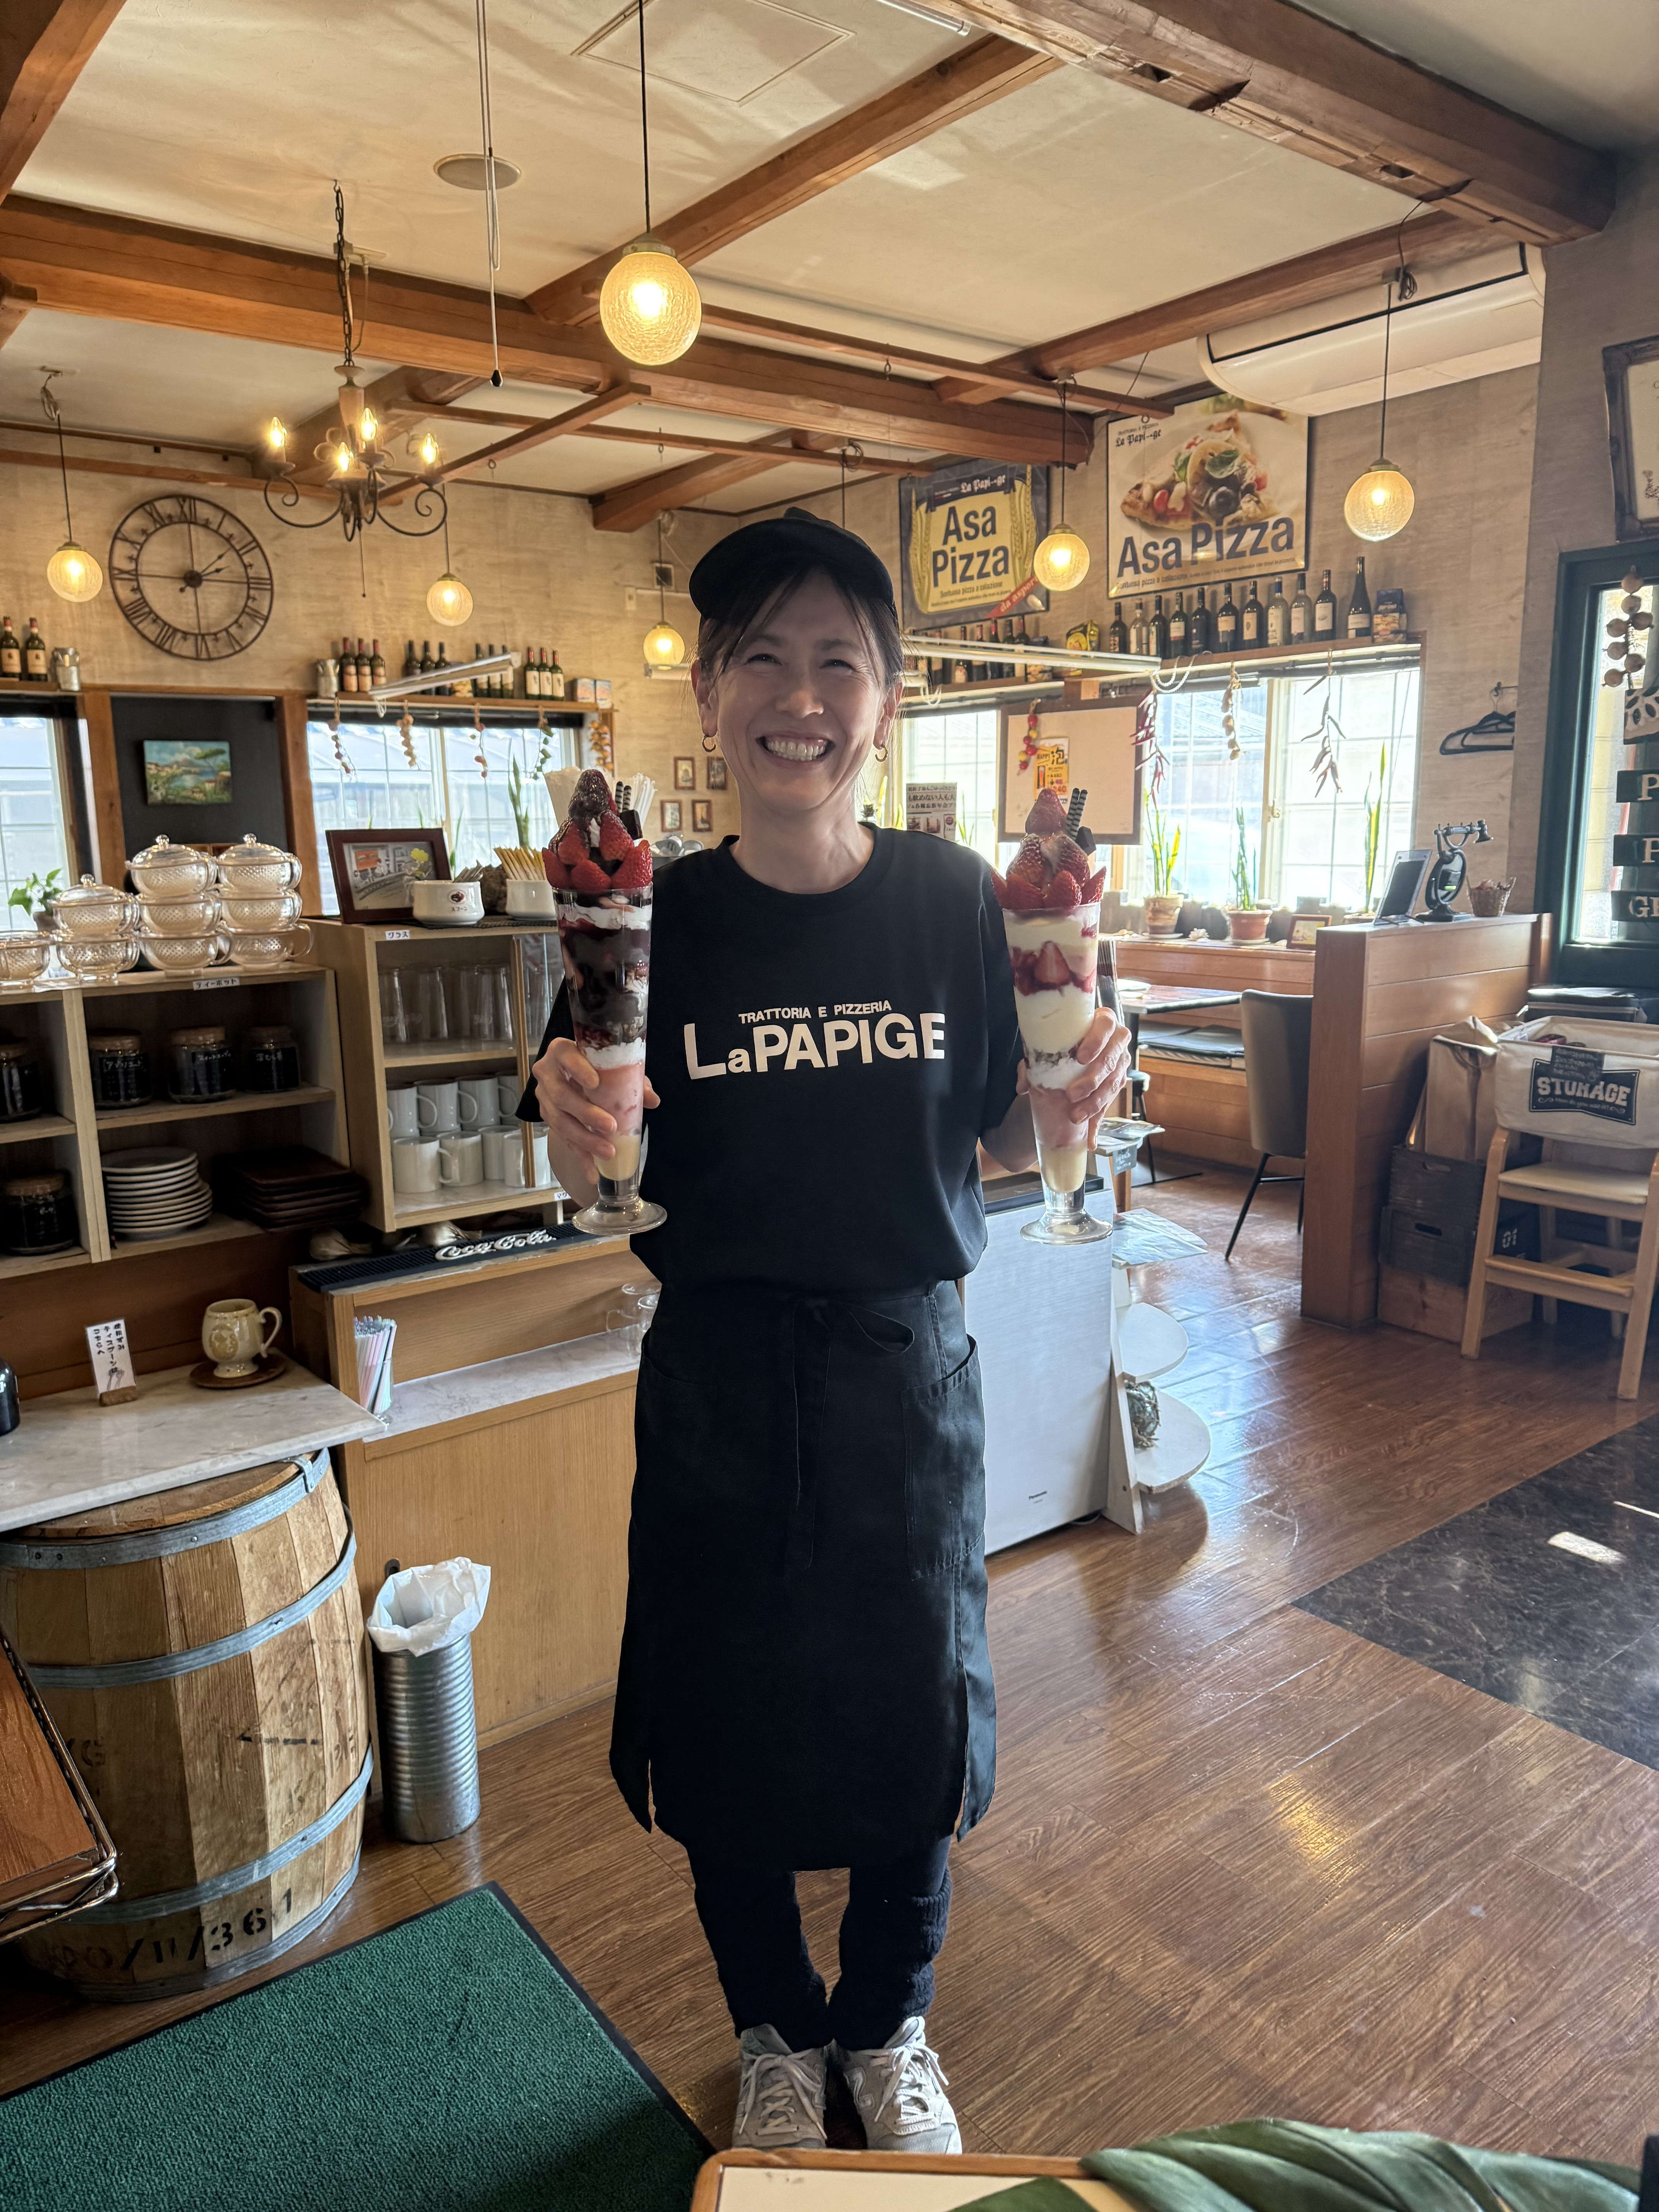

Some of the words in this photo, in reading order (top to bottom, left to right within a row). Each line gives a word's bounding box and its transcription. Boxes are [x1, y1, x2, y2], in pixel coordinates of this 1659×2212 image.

[943, 505, 996, 546] Asa
[932, 545, 1009, 587] Pizza
[1117, 536, 1182, 577] Asa
[1190, 517, 1294, 565] Pizza
[738, 1007, 811, 1024] TRATTORIA
[819, 1006, 828, 1018] E
[834, 1000, 892, 1016] PIZZERIA
[1502, 1228, 1518, 1249] 01
